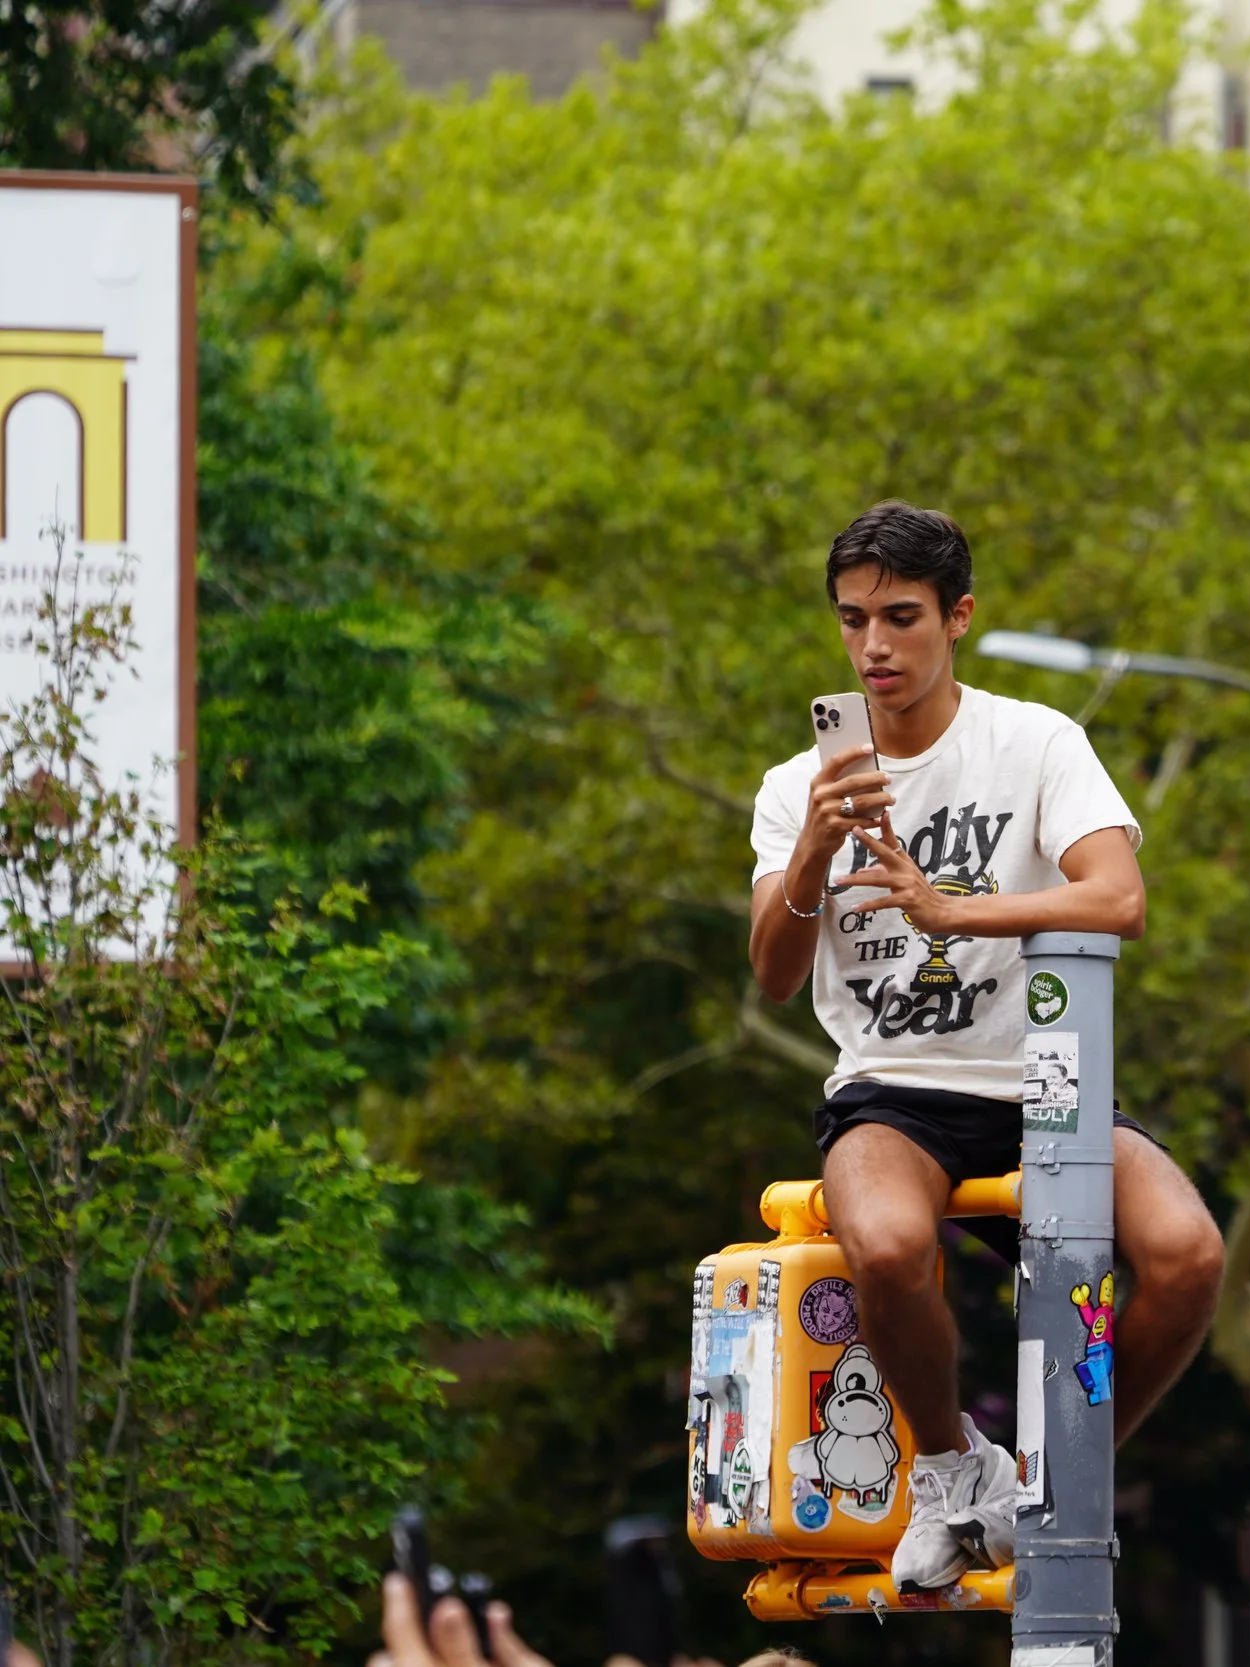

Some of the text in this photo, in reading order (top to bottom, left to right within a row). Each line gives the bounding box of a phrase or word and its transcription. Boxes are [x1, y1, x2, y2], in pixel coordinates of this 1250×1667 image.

[839, 910, 877, 934] OF
[855, 936, 908, 961] THE
[846, 974, 997, 1039] Year
[811, 1281, 844, 1297] DEVILS
